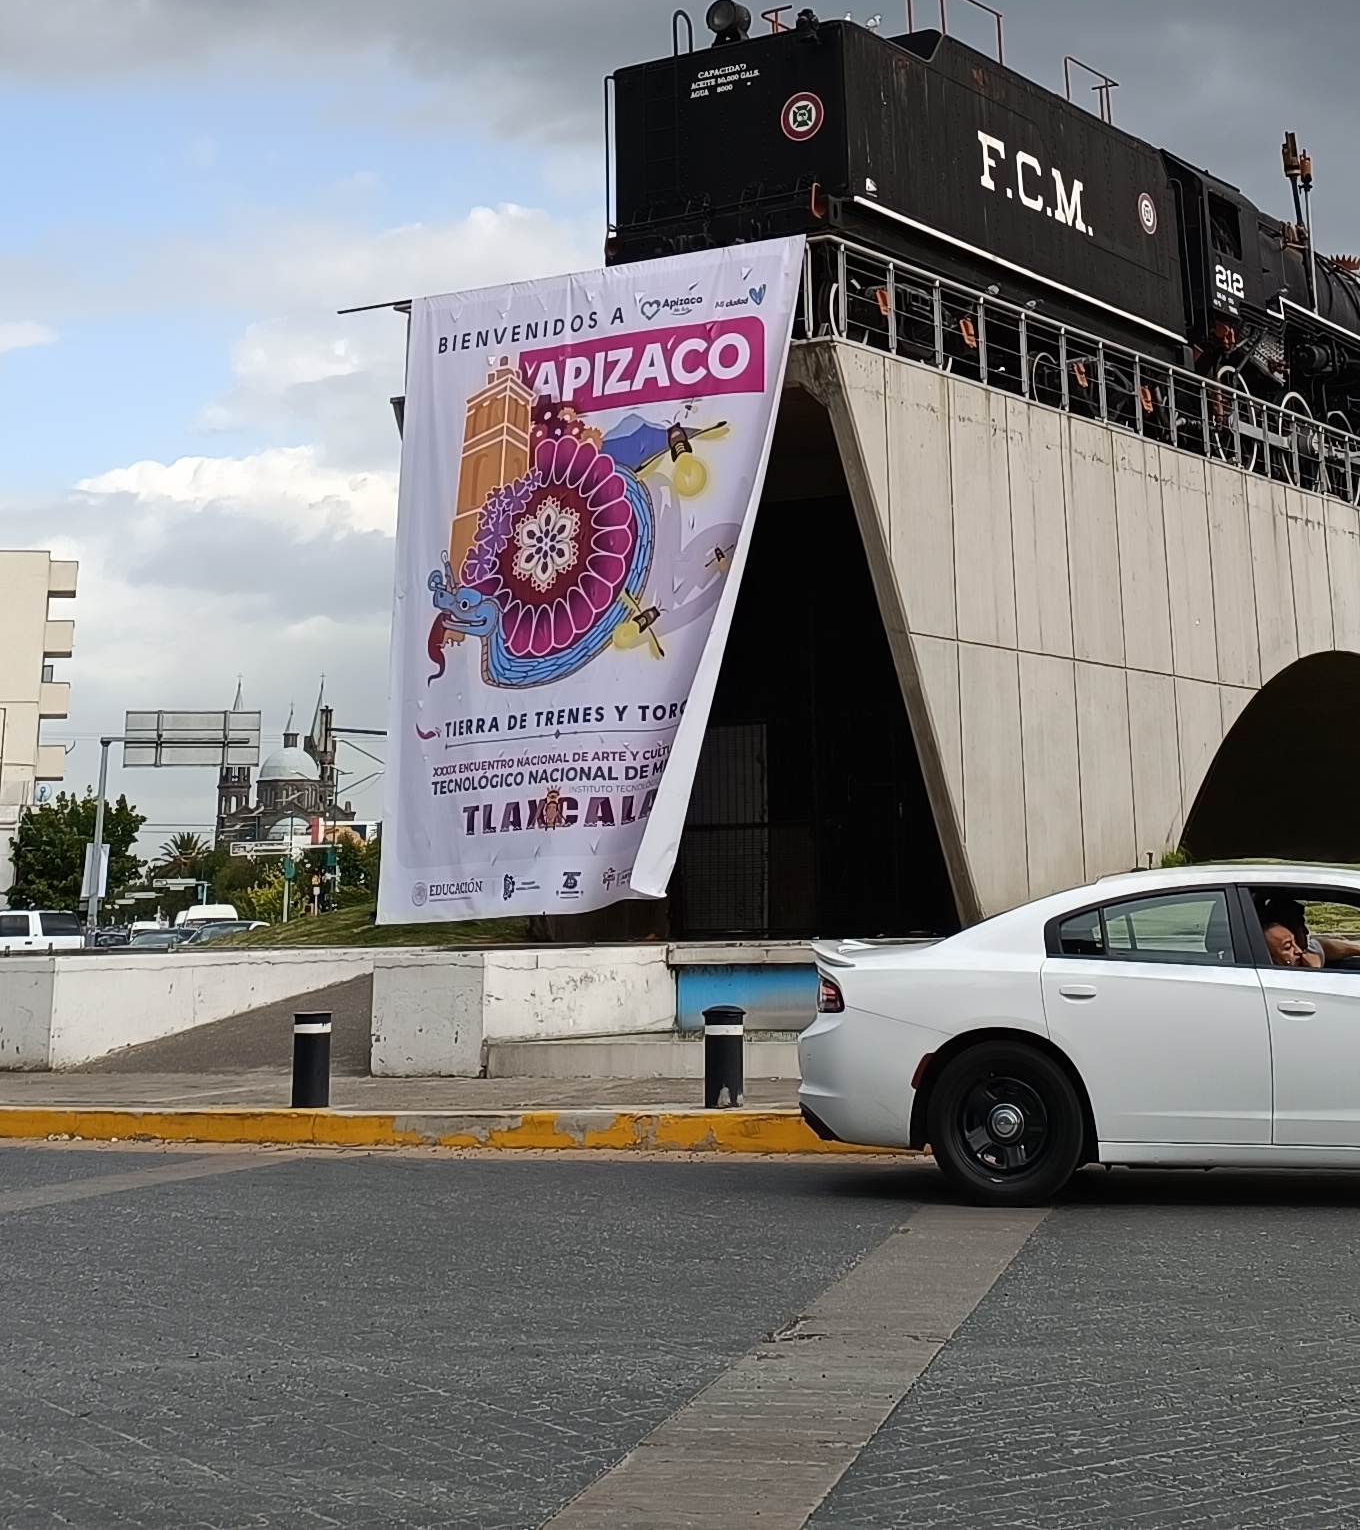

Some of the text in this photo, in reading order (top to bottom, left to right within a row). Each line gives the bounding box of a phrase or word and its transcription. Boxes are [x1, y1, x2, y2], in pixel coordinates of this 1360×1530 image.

[698, 63, 747, 79] CAPACIDAD
[978, 130, 1093, 237] F.C.M.
[1215, 264, 1245, 299] 212
[662, 296, 703, 310] Apizaco
[438, 307, 625, 354] BIENVENIDOS A
[532, 332, 751, 407] APIZACO
[445, 717, 499, 738] TIERRA
[507, 713, 527, 731] DE
[535, 706, 604, 728] TRENES
[614, 705, 628, 722] Y
[459, 756, 514, 774] ENCUENTRO
[517, 752, 570, 769] NACIONAL
[572, 751, 589, 763] DE
[591, 751, 627, 763] ARTE
[629, 750, 640, 762] Y
[431, 771, 524, 796] TECNOLÓGICO
[528, 766, 618, 785] NACIONAL
[624, 765, 648, 781] DE
[568, 785, 613, 794] INSTITUTO
[429, 878, 483, 896] EDUCACIÓN
